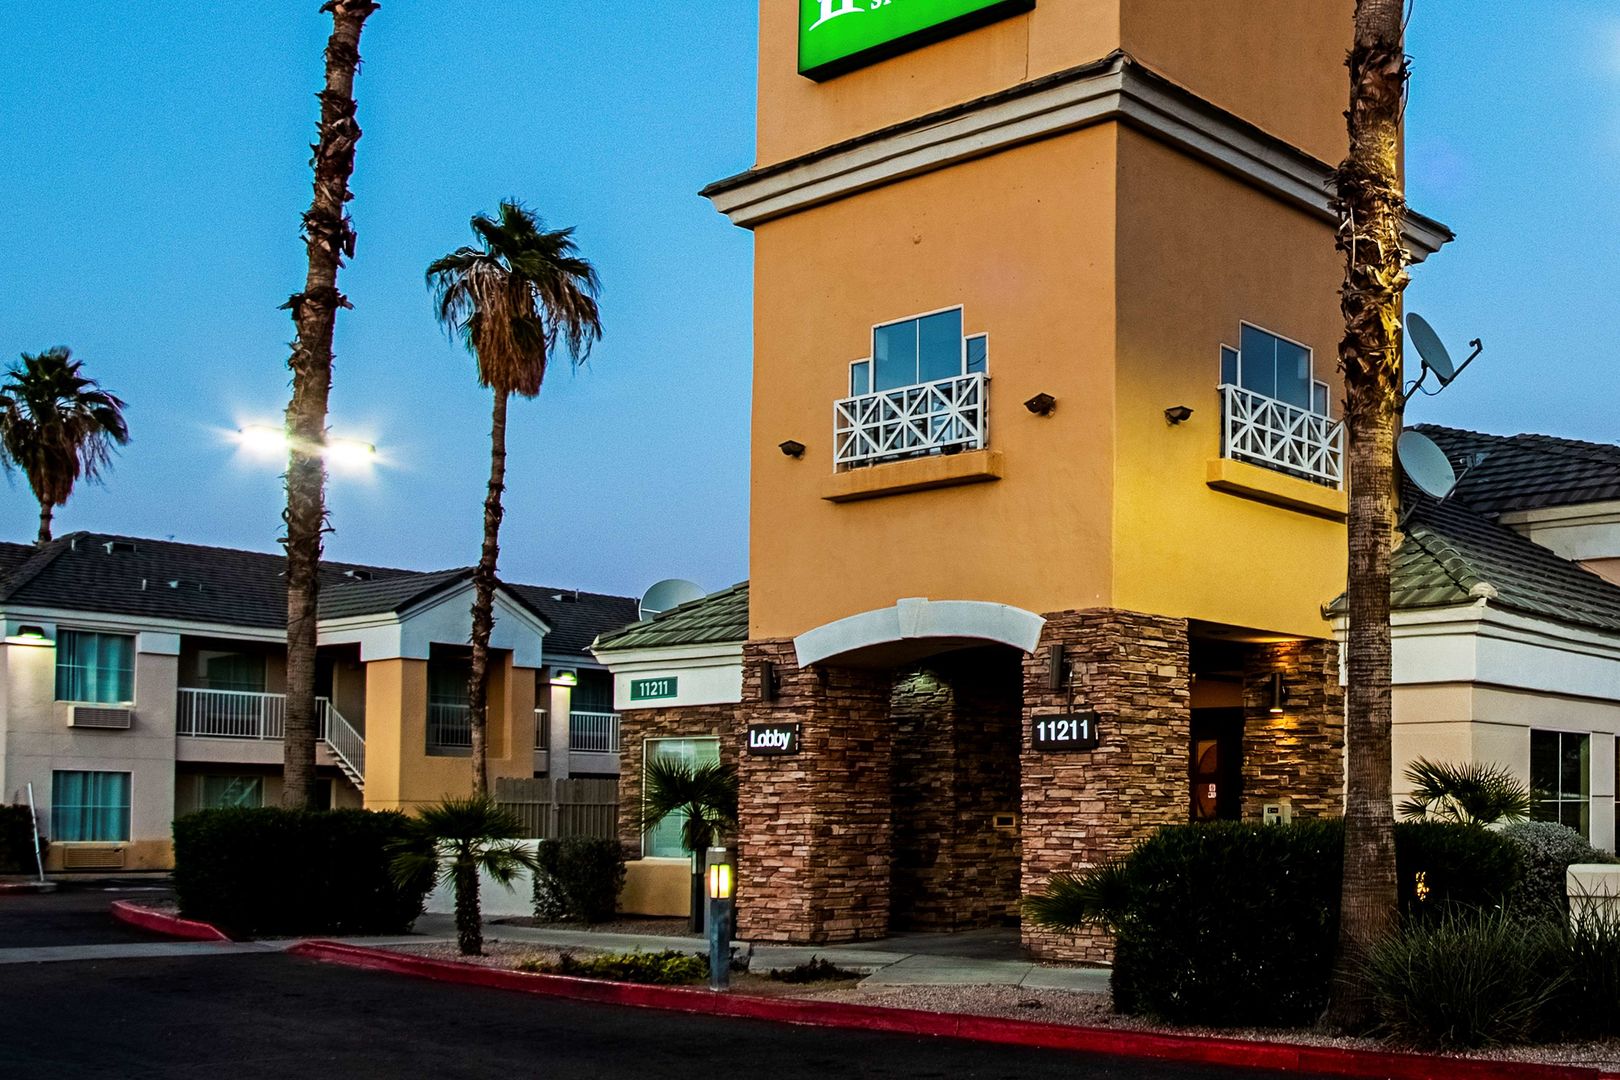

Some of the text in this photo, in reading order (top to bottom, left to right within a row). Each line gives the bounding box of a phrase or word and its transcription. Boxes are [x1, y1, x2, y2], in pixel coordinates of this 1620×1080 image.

[639, 680, 668, 697] 11211
[750, 729, 791, 750] Lobby
[1036, 719, 1089, 742] 11211
